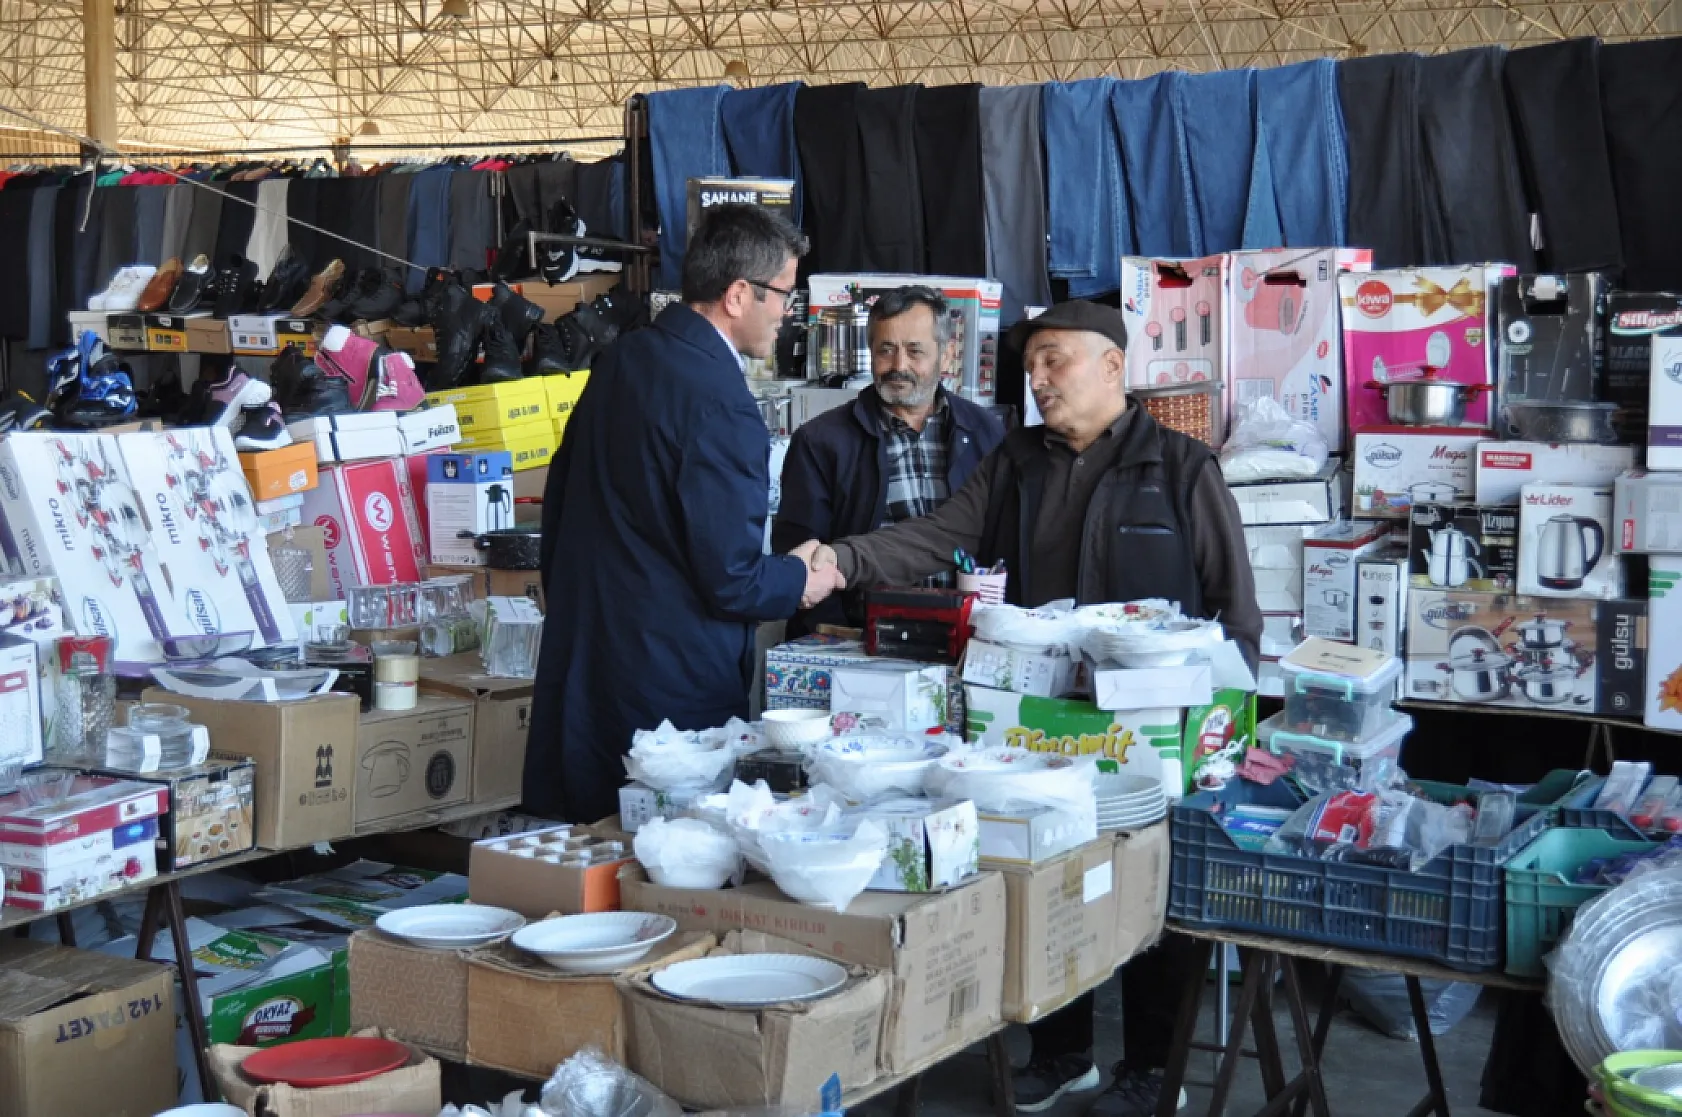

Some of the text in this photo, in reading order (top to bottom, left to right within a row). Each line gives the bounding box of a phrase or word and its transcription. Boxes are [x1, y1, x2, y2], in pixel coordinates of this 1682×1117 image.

[49, 497, 75, 551] mikro
[156, 492, 182, 545] mikro
[1610, 613, 1635, 670] gülsu
[54, 993, 164, 1043] 142 PAKET
